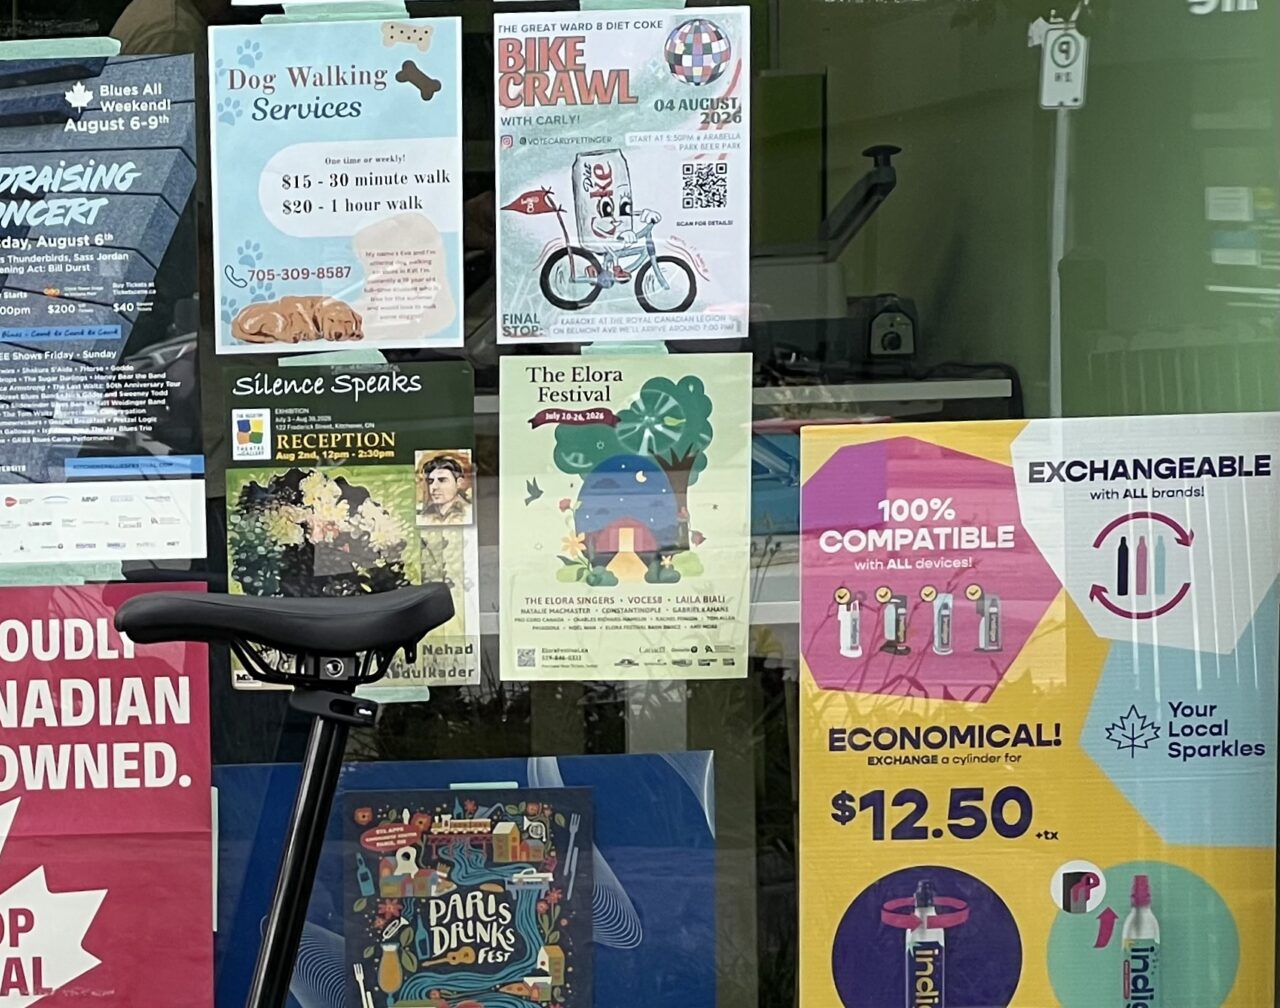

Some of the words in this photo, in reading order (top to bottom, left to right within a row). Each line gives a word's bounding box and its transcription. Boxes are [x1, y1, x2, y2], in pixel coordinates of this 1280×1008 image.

[498, 24, 519, 34] THE
[521, 23, 557, 33] GREAT
[559, 22, 594, 32] WARD
[606, 21, 631, 31] DIET
[633, 20, 664, 30] COKE
[498, 36, 586, 73] BIKE
[228, 68, 277, 95] Dog
[285, 64, 388, 91] Walking
[100, 85, 138, 97] Blues
[143, 83, 162, 96] All
[498, 69, 639, 109] CRAWL
[100, 99, 171, 112] Weekend!
[251, 96, 362, 121] Services
[654, 99, 676, 112] 04
[64, 118, 125, 133] August
[130, 115, 170, 130] 6-9th
[501, 116, 533, 127] WITH
[535, 115, 581, 126] CARLY!
[700, 111, 742, 125] 2026
[325, 156, 341, 165] One
[343, 155, 361, 165] time
[375, 154, 406, 165] weekly!
[281, 173, 312, 190] $15
[329, 171, 349, 188] 30
[354, 170, 409, 187] minute
[413, 168, 451, 185] walk
[282, 198, 313, 215] $20
[345, 196, 381, 213] hour
[386, 195, 424, 211] walk
[37, 235, 90, 250] August
[94, 232, 114, 247] 6th
[7, 254, 71, 266] Thunderbirds,
[73, 254, 94, 262] Sass
[96, 252, 129, 262] Jordan
[27, 264, 46, 273] Act:
[48, 263, 63, 272] Bill
[66, 263, 90, 272] Durst
[247, 266, 352, 282] 705-309-8587
[3, 291, 28, 299] Starts
[47, 304, 75, 314] $200
[113, 302, 134, 312] $40
[503, 313, 540, 325] FINAL
[502, 325, 543, 337] STOP:
[13, 351, 42, 361] Shows
[44, 351, 74, 360] Friday
[83, 350, 117, 359] Sunday
[526, 366, 565, 383] The
[571, 366, 624, 383] Elora
[232, 373, 325, 396] Silence
[331, 371, 422, 402] Speaks
[538, 386, 611, 402] Festival
[277, 432, 396, 449] RECEPTION
[275, 451, 295, 461] Aug
[298, 451, 319, 460] 2nd,
[322, 450, 349, 460] 12pm
[358, 449, 395, 459] 2:30pm
[1028, 454, 1272, 484] EXCHANGEABLE
[1089, 488, 1119, 500] with
[1123, 487, 1149, 499] ALL
[1152, 485, 1205, 499] brands!
[877, 497, 956, 522] 100%
[820, 524, 1016, 554] COMPATIBLE
[854, 557, 883, 571] with
[886, 557, 913, 570] ALL
[915, 556, 974, 570] devices!
[525, 596, 542, 605] THE
[545, 596, 575, 605] ELORA
[577, 596, 615, 605] SINGERS
[676, 595, 701, 604] LAILA
[703, 595, 726, 604] BIALI
[601, 606, 661, 614] CONSTANTINOPLE
[422, 643, 473, 656] Nehad
[1168, 701, 1218, 718] Your
[828, 722, 1062, 752] ECONOMICAL!
[1168, 720, 1229, 738] Local
[1168, 739, 1267, 762] Sparkles
[867, 754, 939, 767] EXCHANGE
[941, 756, 950, 765] a
[952, 752, 1002, 767] cylinder
[1003, 752, 1022, 764] for
[831, 785, 1034, 841] $12.50
[429, 891, 512, 927] PARIS
[430, 921, 516, 957] DRINKS
[478, 948, 511, 964] FEST
